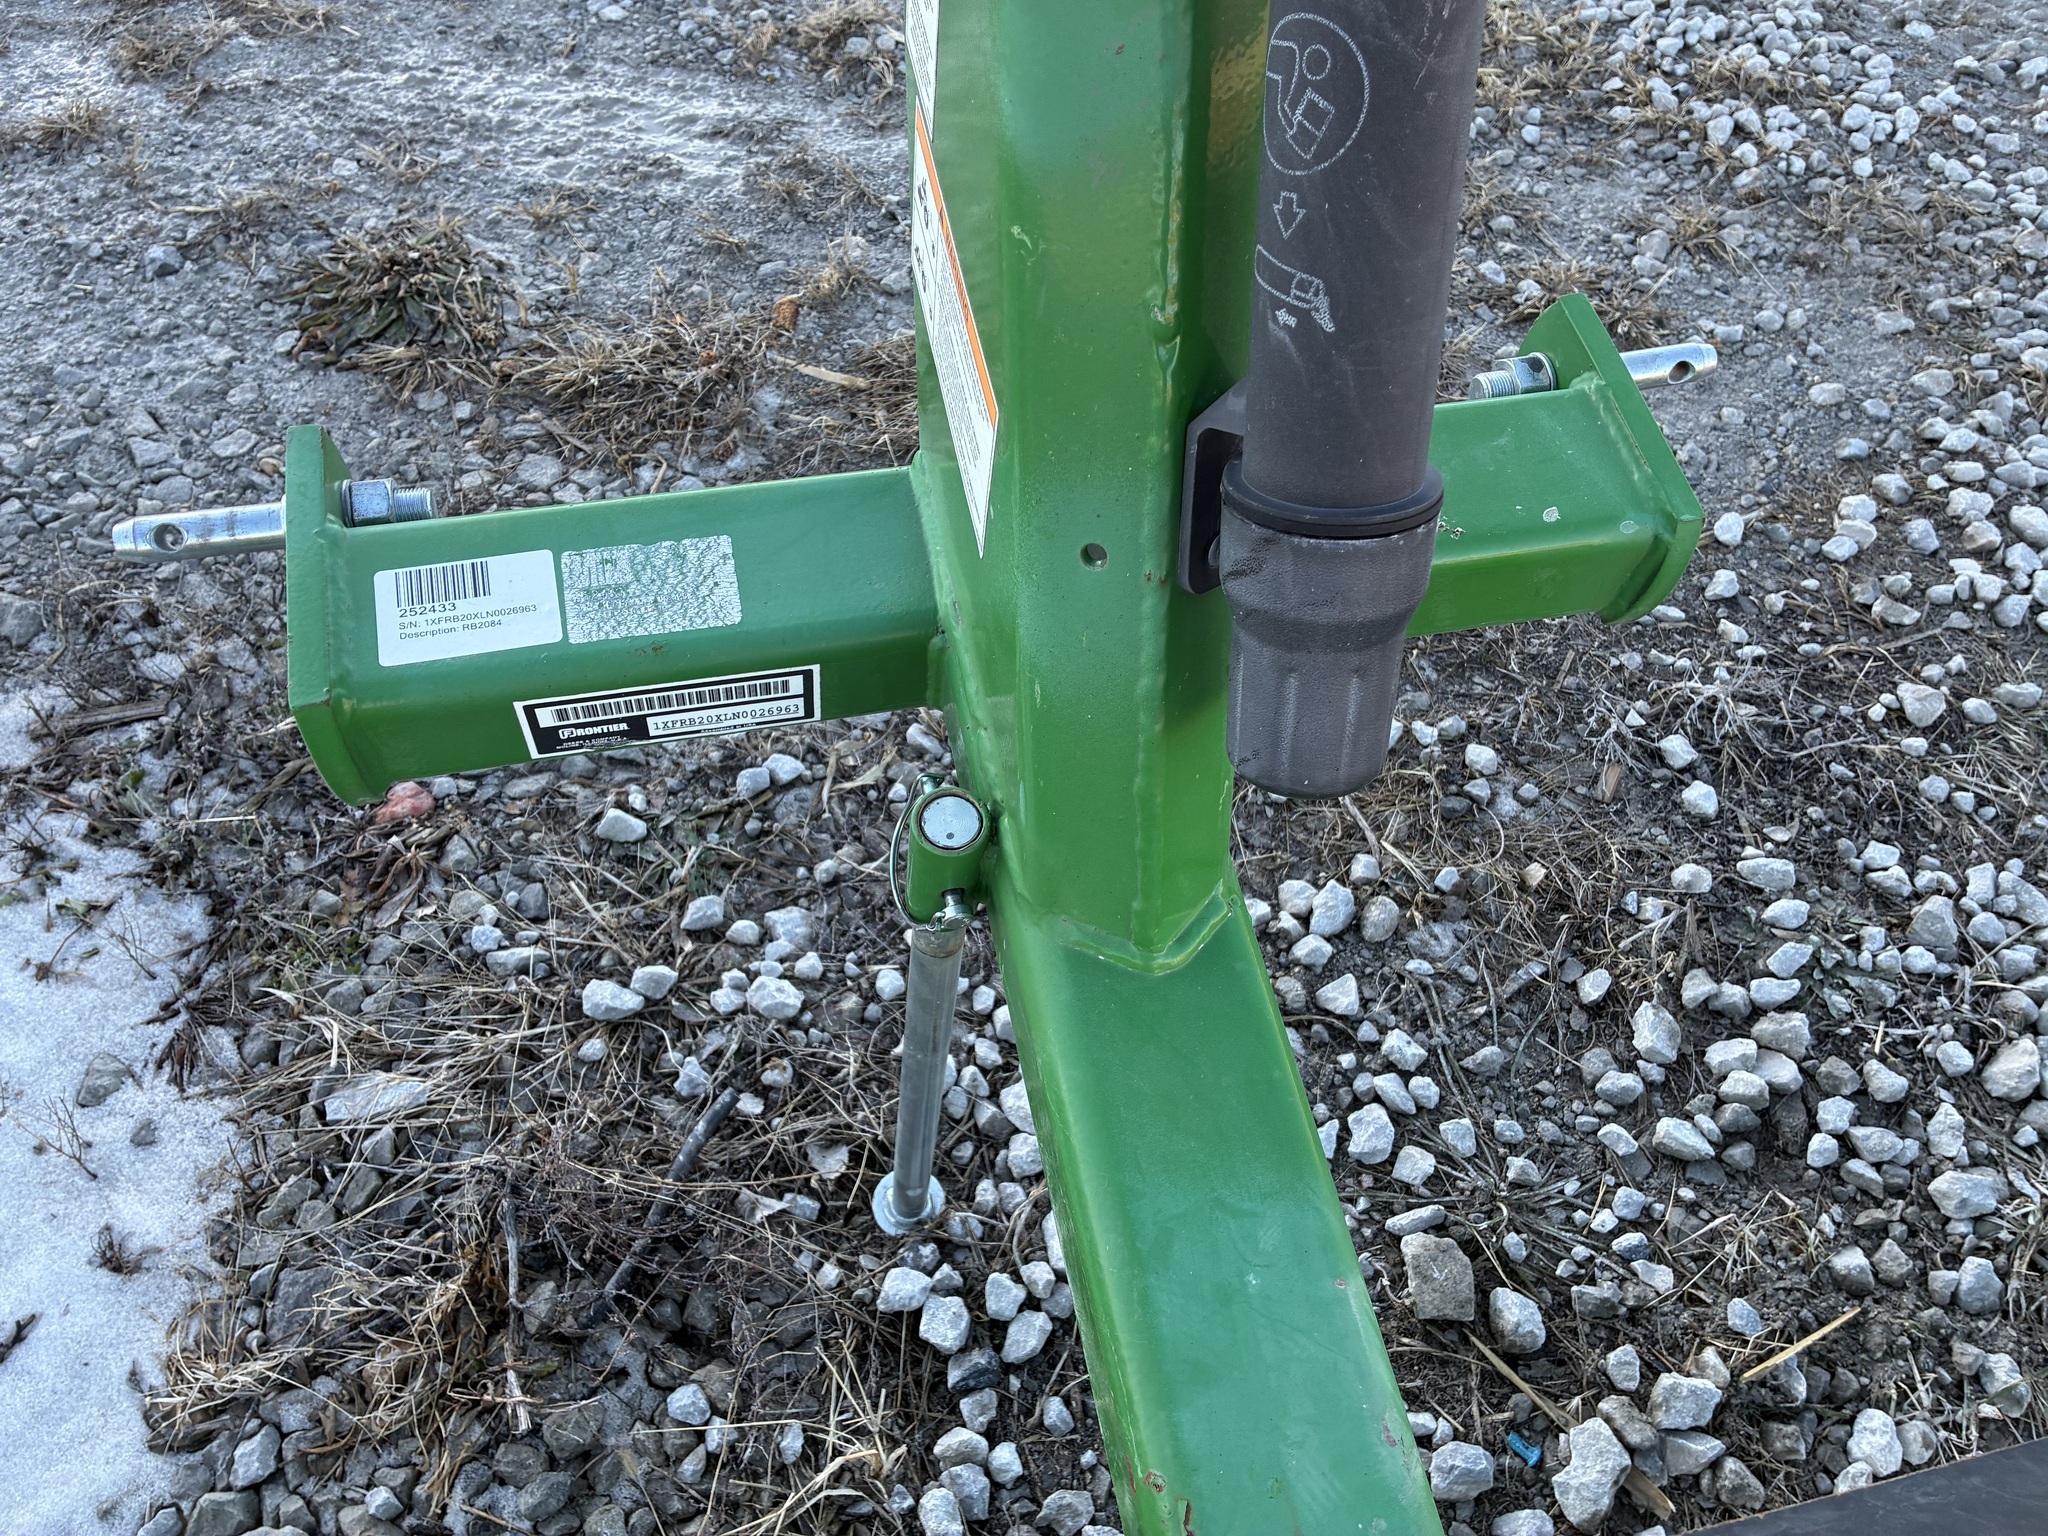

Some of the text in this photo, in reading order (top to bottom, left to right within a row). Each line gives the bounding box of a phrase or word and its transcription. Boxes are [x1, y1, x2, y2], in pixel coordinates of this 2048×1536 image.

[399, 602, 457, 618] 252433
[399, 604, 538, 630] S/N: 1XFRB20XLN0026963
[399, 619, 502, 640] Description: RB2084
[653, 704, 800, 730] 1XFRB20XLN0026963
[558, 723, 630, 739] FRONTIER
